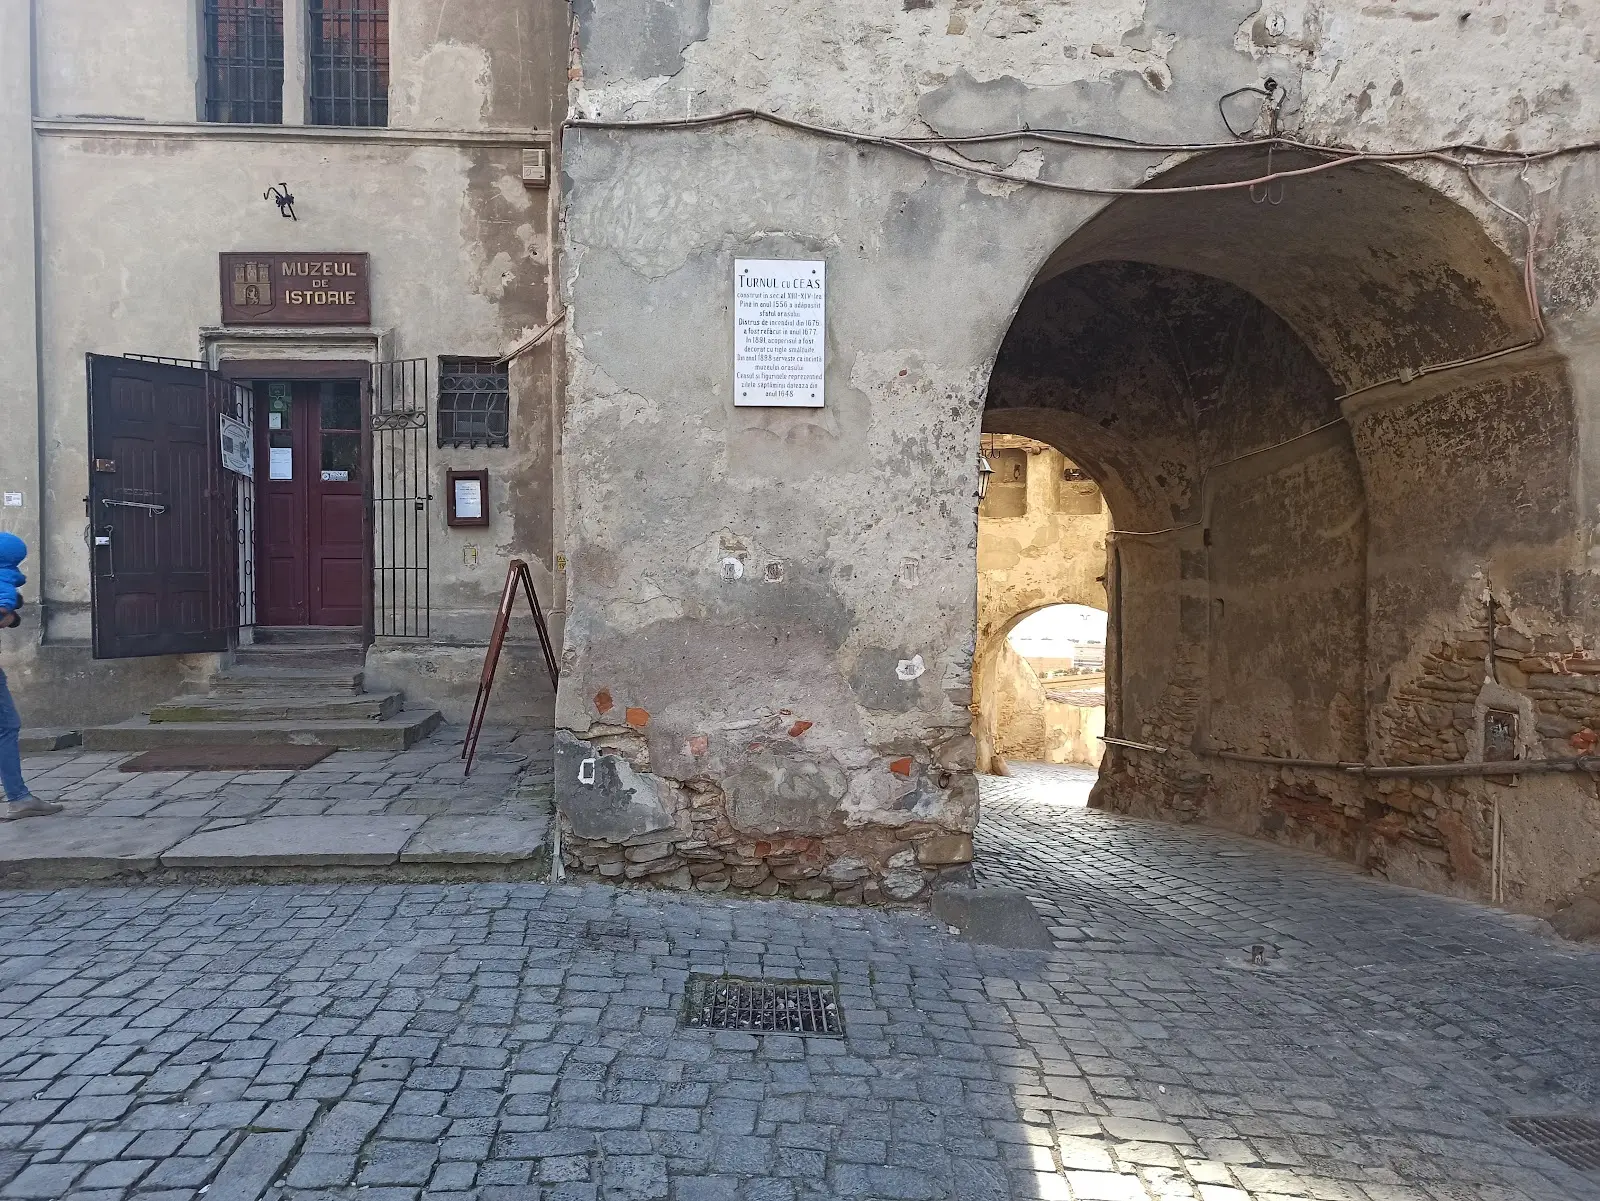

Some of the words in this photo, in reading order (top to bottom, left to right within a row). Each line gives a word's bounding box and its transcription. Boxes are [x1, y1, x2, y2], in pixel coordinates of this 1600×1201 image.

[282, 262, 357, 276] MUZEUL
[312, 279, 329, 288] DE
[738, 275, 779, 288] TURNUL
[285, 290, 356, 305] ISTORIE
[738, 318, 760, 326] Distrus
